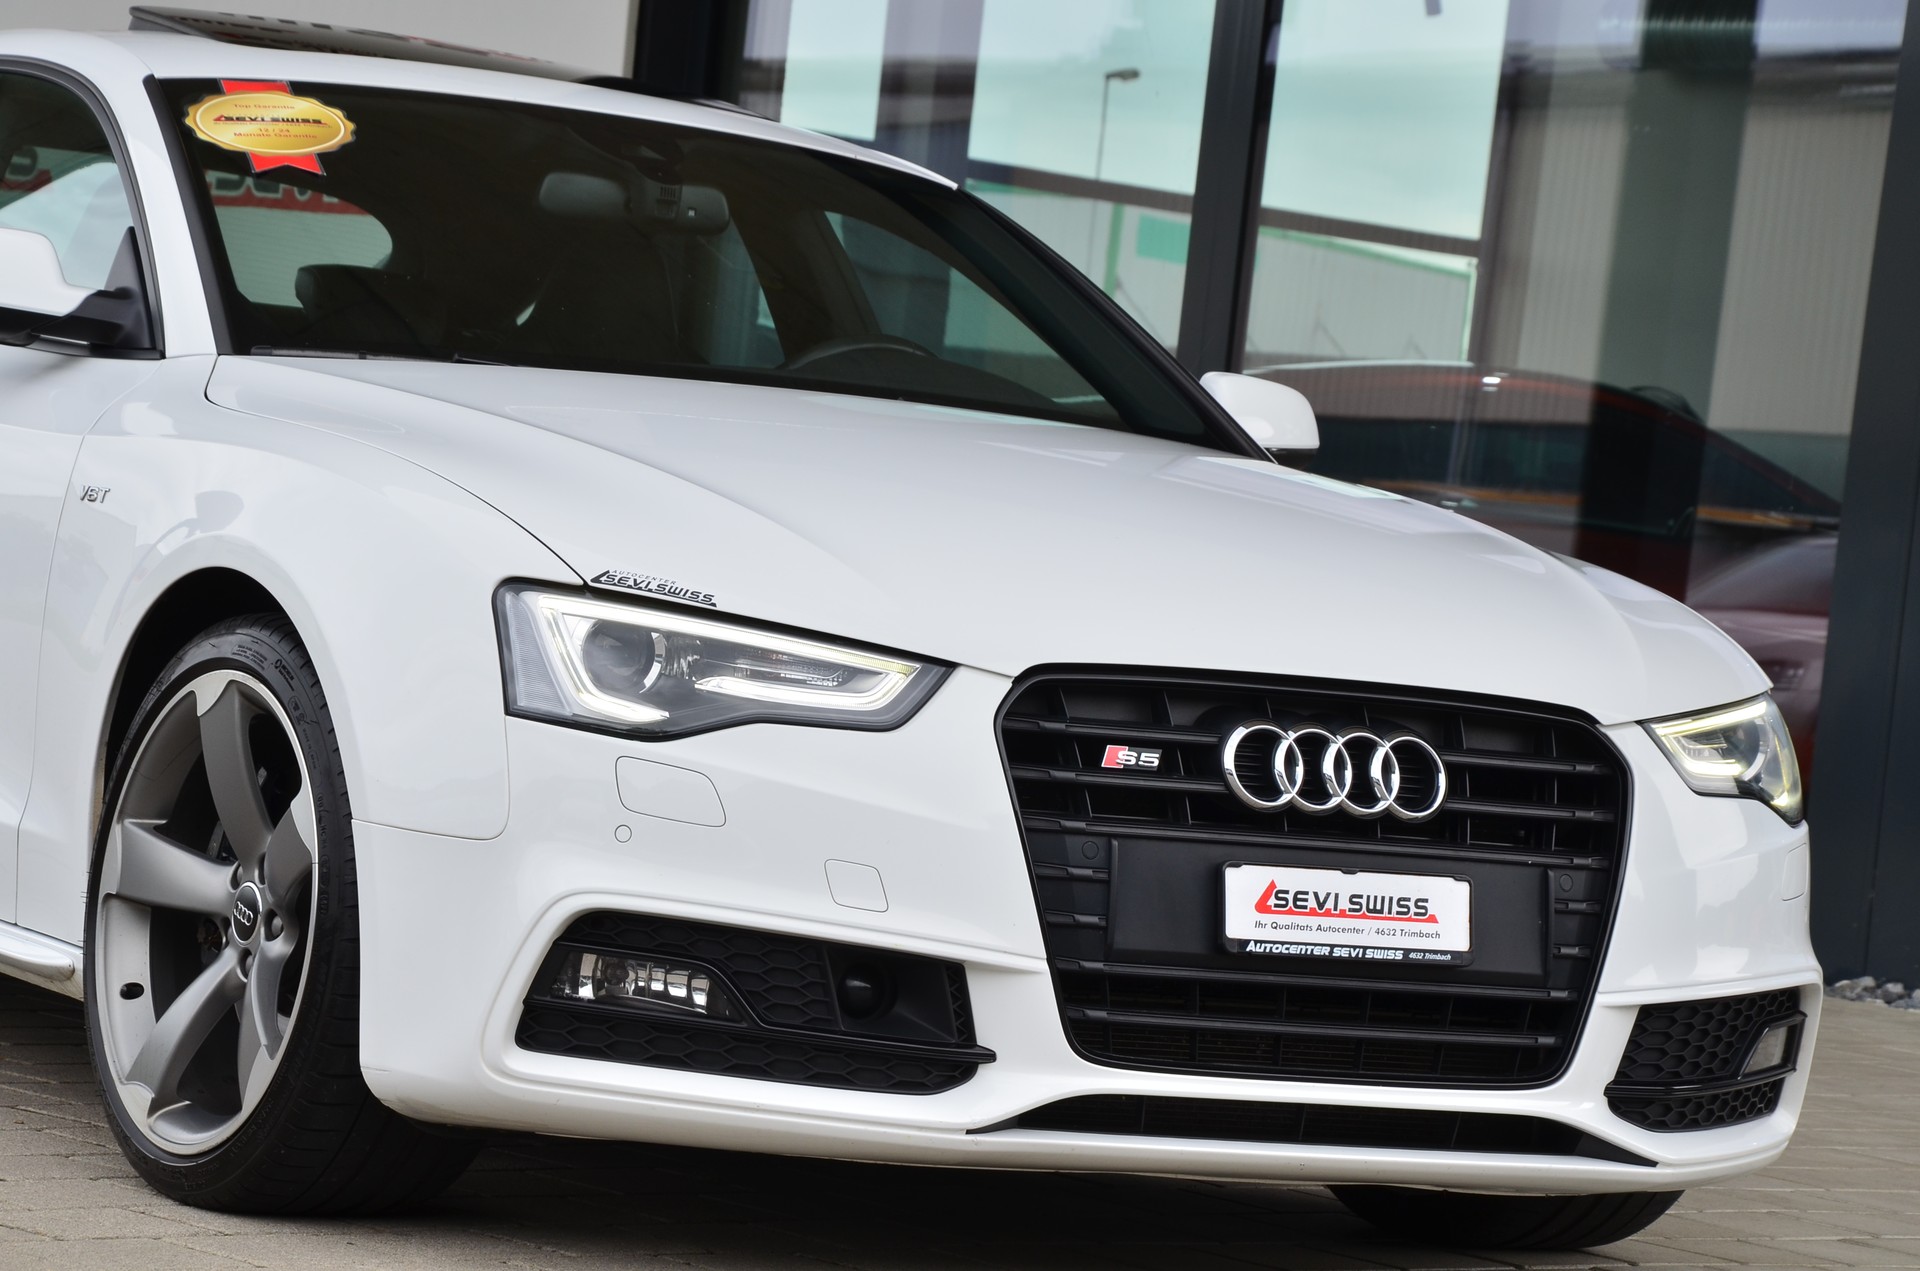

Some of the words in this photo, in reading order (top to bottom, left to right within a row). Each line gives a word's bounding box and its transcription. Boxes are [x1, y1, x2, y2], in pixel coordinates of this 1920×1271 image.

[270, 117, 323, 125] SWISS
[611, 569, 677, 585] AUTOCENTER
[603, 574, 655, 590] SEVI
[655, 583, 715, 603] SWISS
[1271, 888, 1340, 913] SEVI
[1347, 893, 1430, 918] SWISS
[1254, 920, 1268, 930] Ihr
[1270, 921, 1313, 933] Qualitats
[1315, 923, 1366, 936] Autocenter
[1374, 926, 1397, 938] 4632
[1399, 928, 1441, 940] Trimbach
[1332, 946, 1363, 959] SEVI
[1365, 948, 1404, 961] SWISS
[1408, 951, 1424, 960] 4632
[1424, 951, 1452, 962] Trimbach
